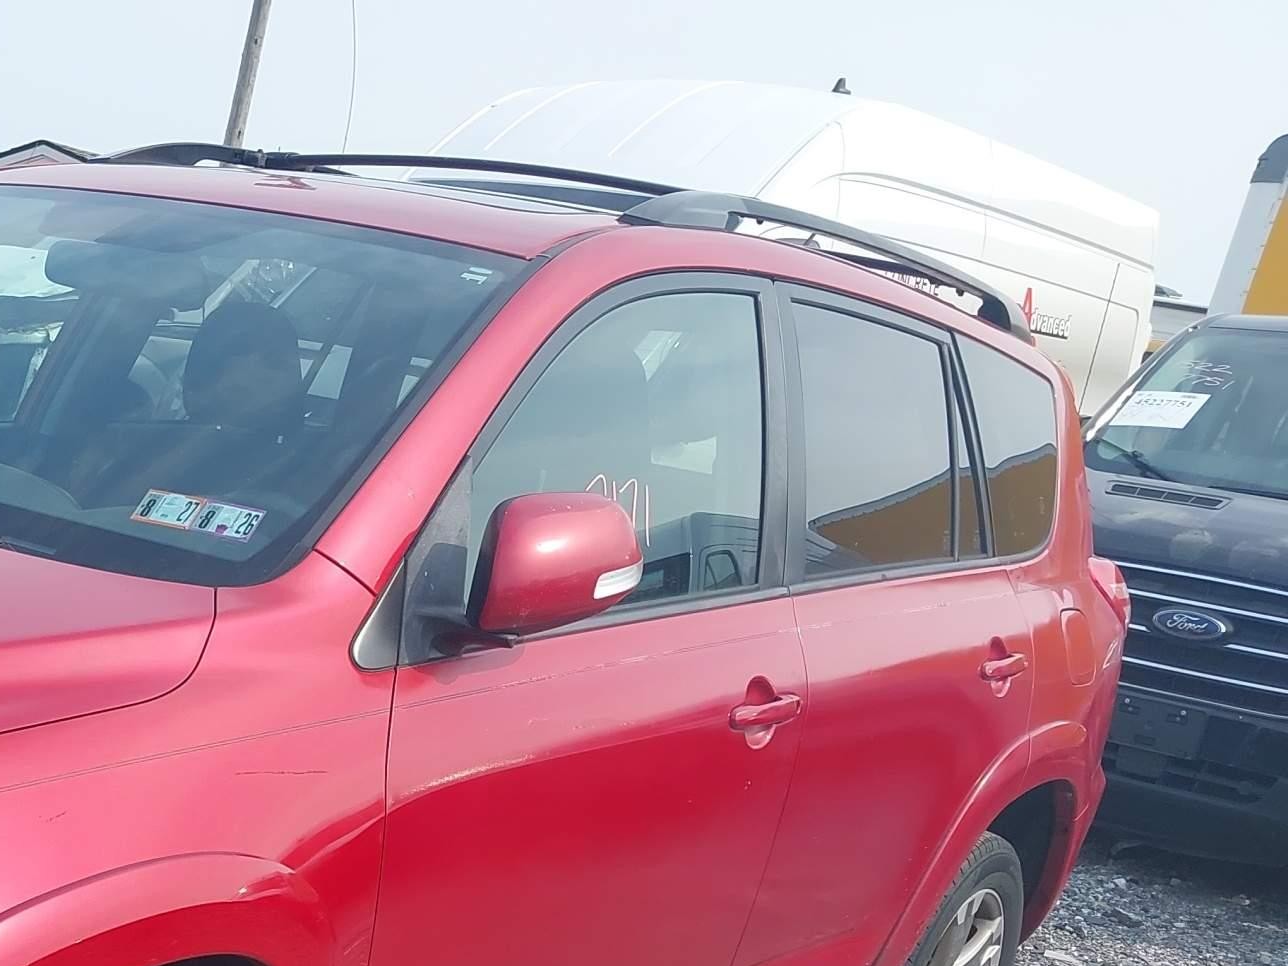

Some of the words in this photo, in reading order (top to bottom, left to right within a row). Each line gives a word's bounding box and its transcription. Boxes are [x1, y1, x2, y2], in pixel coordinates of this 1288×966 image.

[1017, 288, 1073, 337] Advanced
[176, 501, 200, 522] 27
[235, 512, 260, 535] 26
[1167, 614, 1209, 633] Ford
